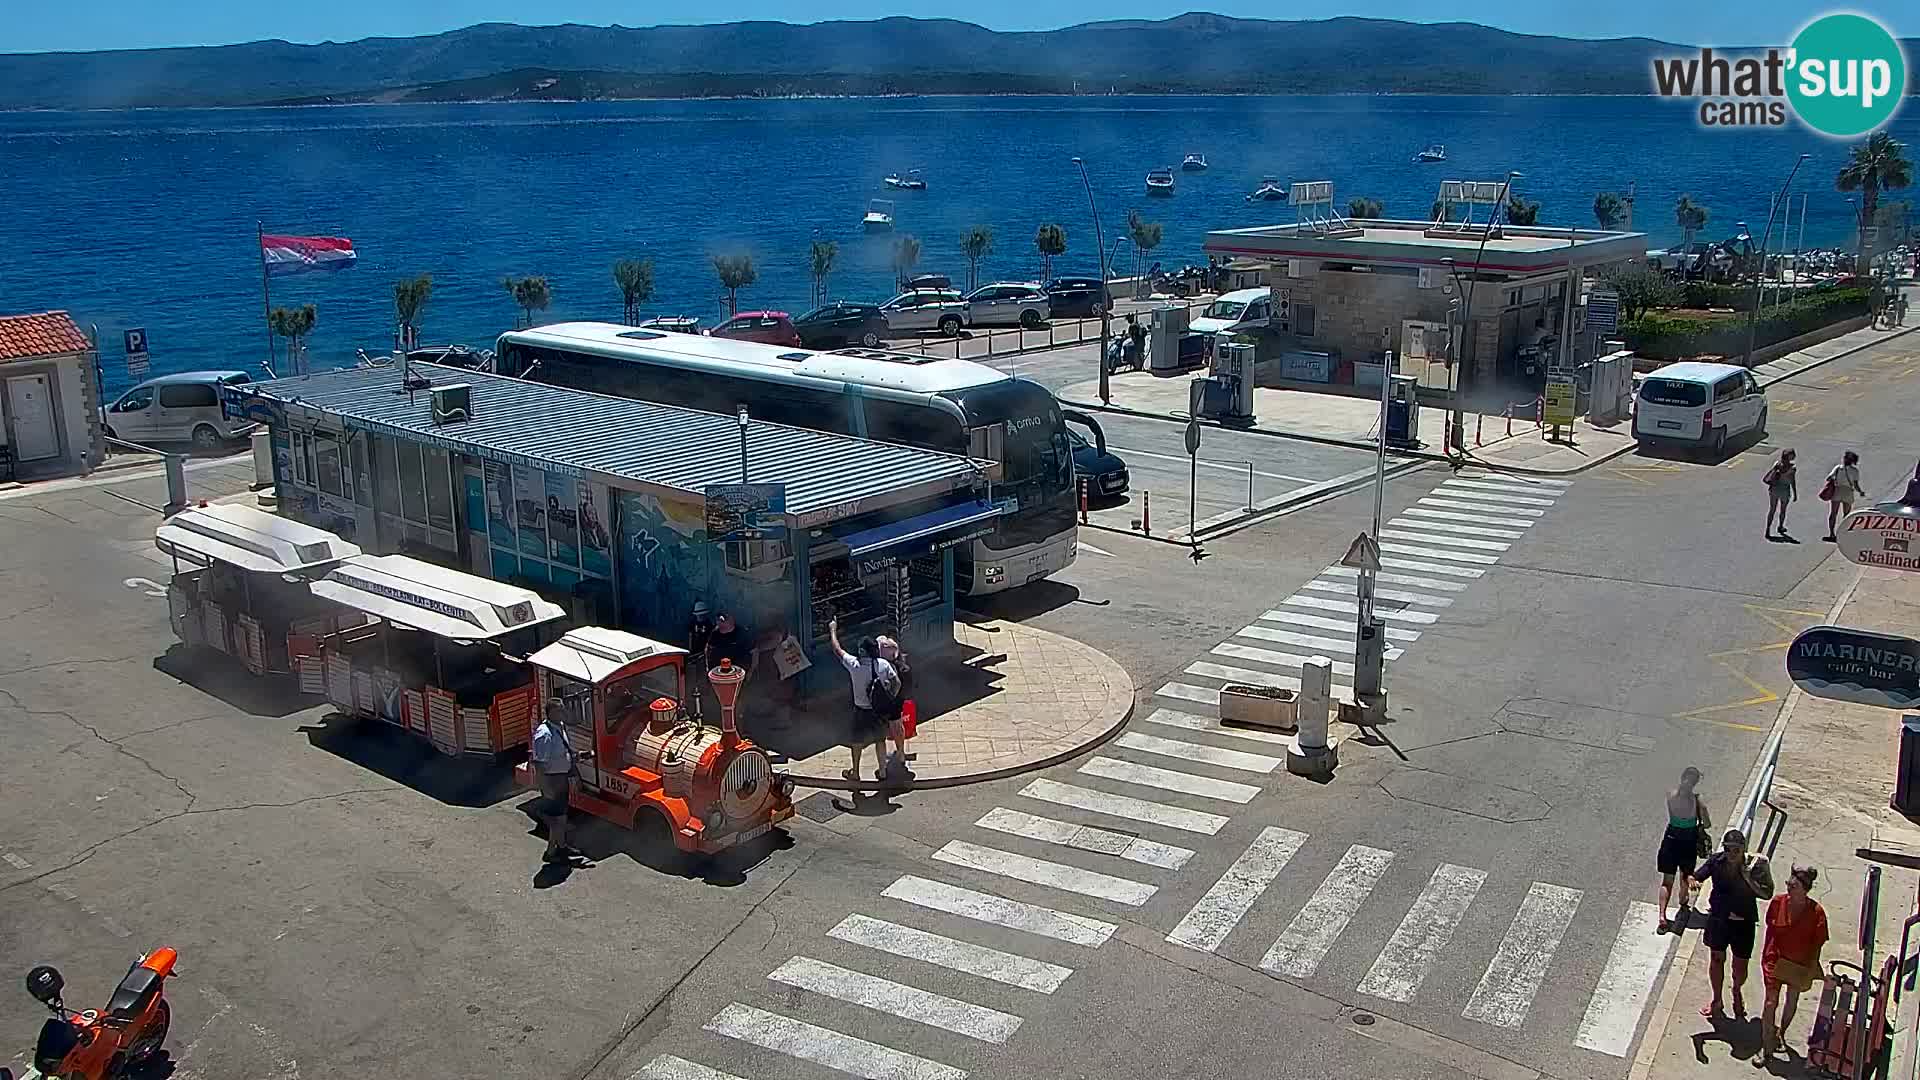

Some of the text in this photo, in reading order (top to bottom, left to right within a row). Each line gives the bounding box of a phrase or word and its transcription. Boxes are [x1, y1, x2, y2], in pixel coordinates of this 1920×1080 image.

[129, 332, 141, 350] P
[1666, 381, 1684, 389] TAXI
[493, 449, 525, 465] STATION
[528, 456, 554, 471] TICKET
[555, 462, 581, 477] OFFICE
[1880, 530, 1916, 541] GRILL
[429, 599, 442, 610] BOL
[442, 602, 468, 618] CENTER
[1827, 662, 1896, 680] caffe bar
